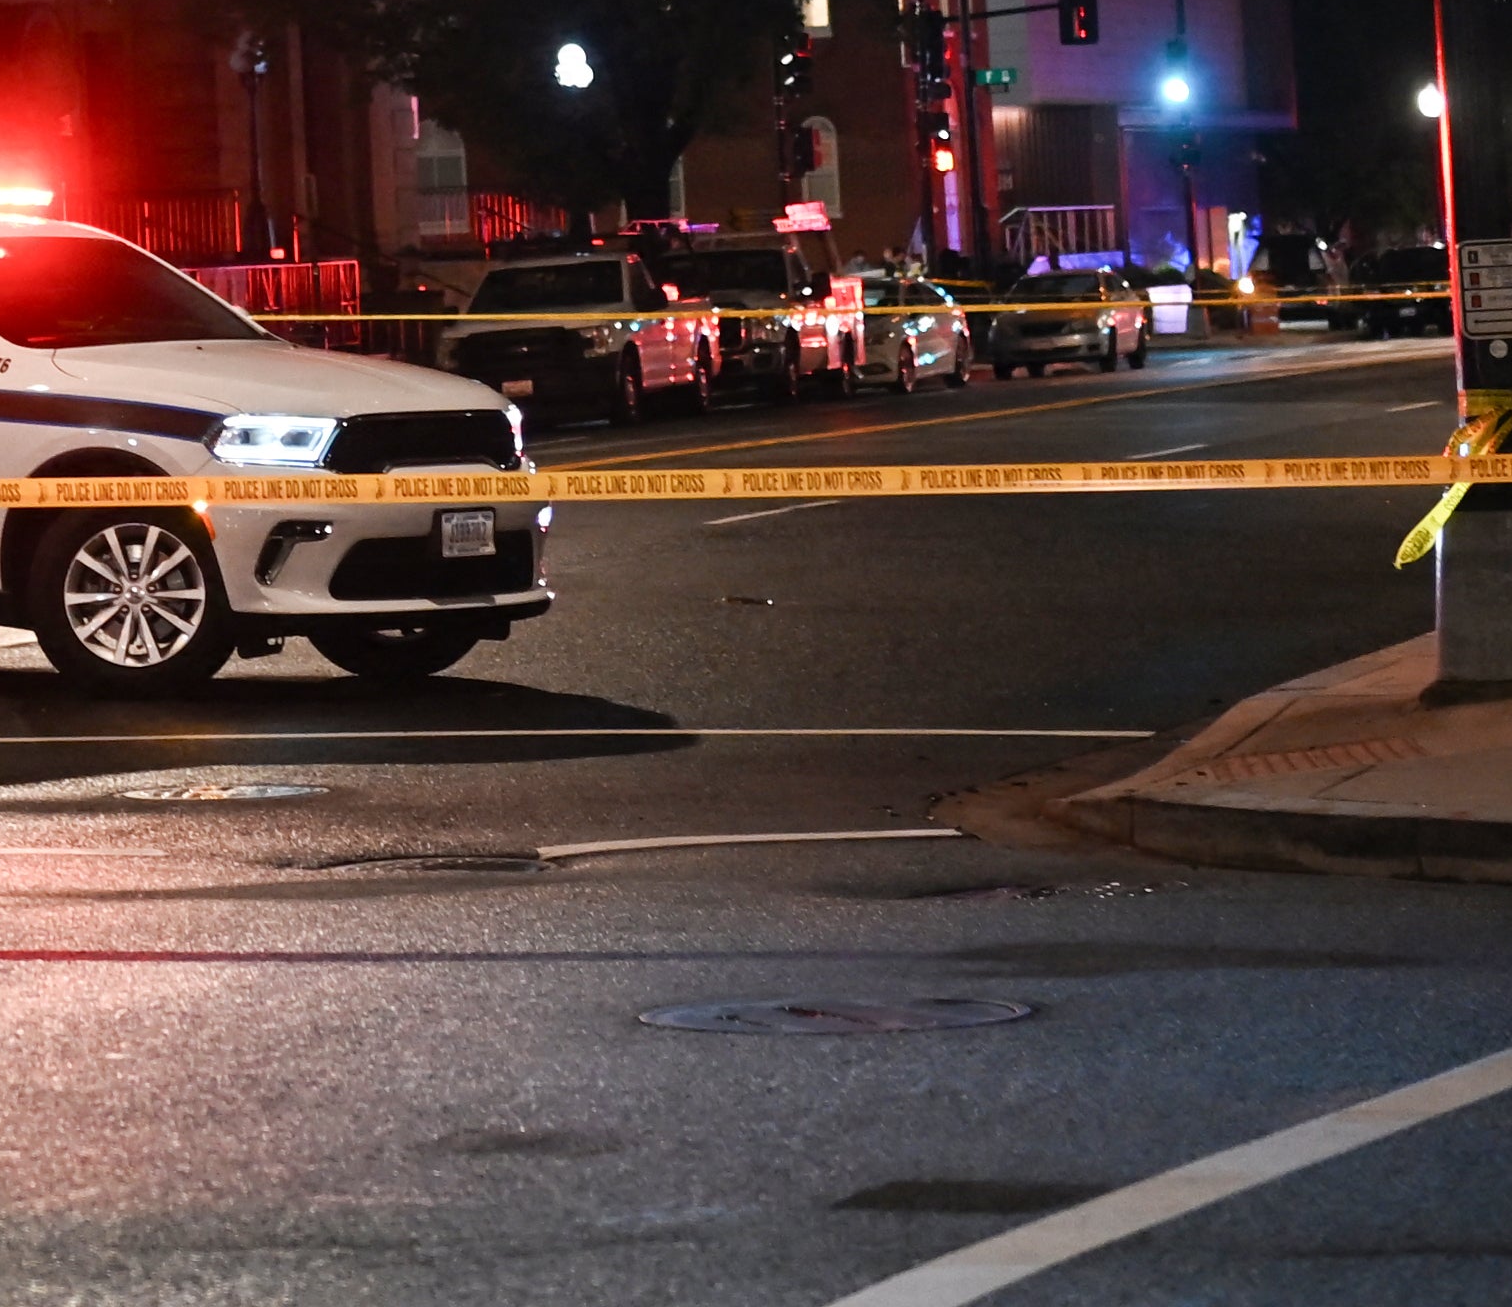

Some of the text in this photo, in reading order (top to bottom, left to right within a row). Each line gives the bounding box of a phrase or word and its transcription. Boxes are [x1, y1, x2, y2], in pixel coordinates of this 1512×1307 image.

[920, 467, 1062, 489] POLICE LINE DO NOT CROSS
[1101, 464, 1245, 485] POLICE LINE DO NOT CROSS
[1284, 460, 1430, 482] POLICE LINE DO NOT CROSS
[1470, 458, 1508, 478] POLICE
[56, 481, 188, 502] POLICE LINE DO NOT CROSS
[224, 479, 358, 500] POLICE LINE DO NOT CROSS
[394, 476, 530, 497] POLICE LINE DO NOT CROSS
[567, 474, 704, 495] POLICE LINE DO NOT CROSS
[743, 470, 882, 492] POLICE LINE DO NOT CROSS
